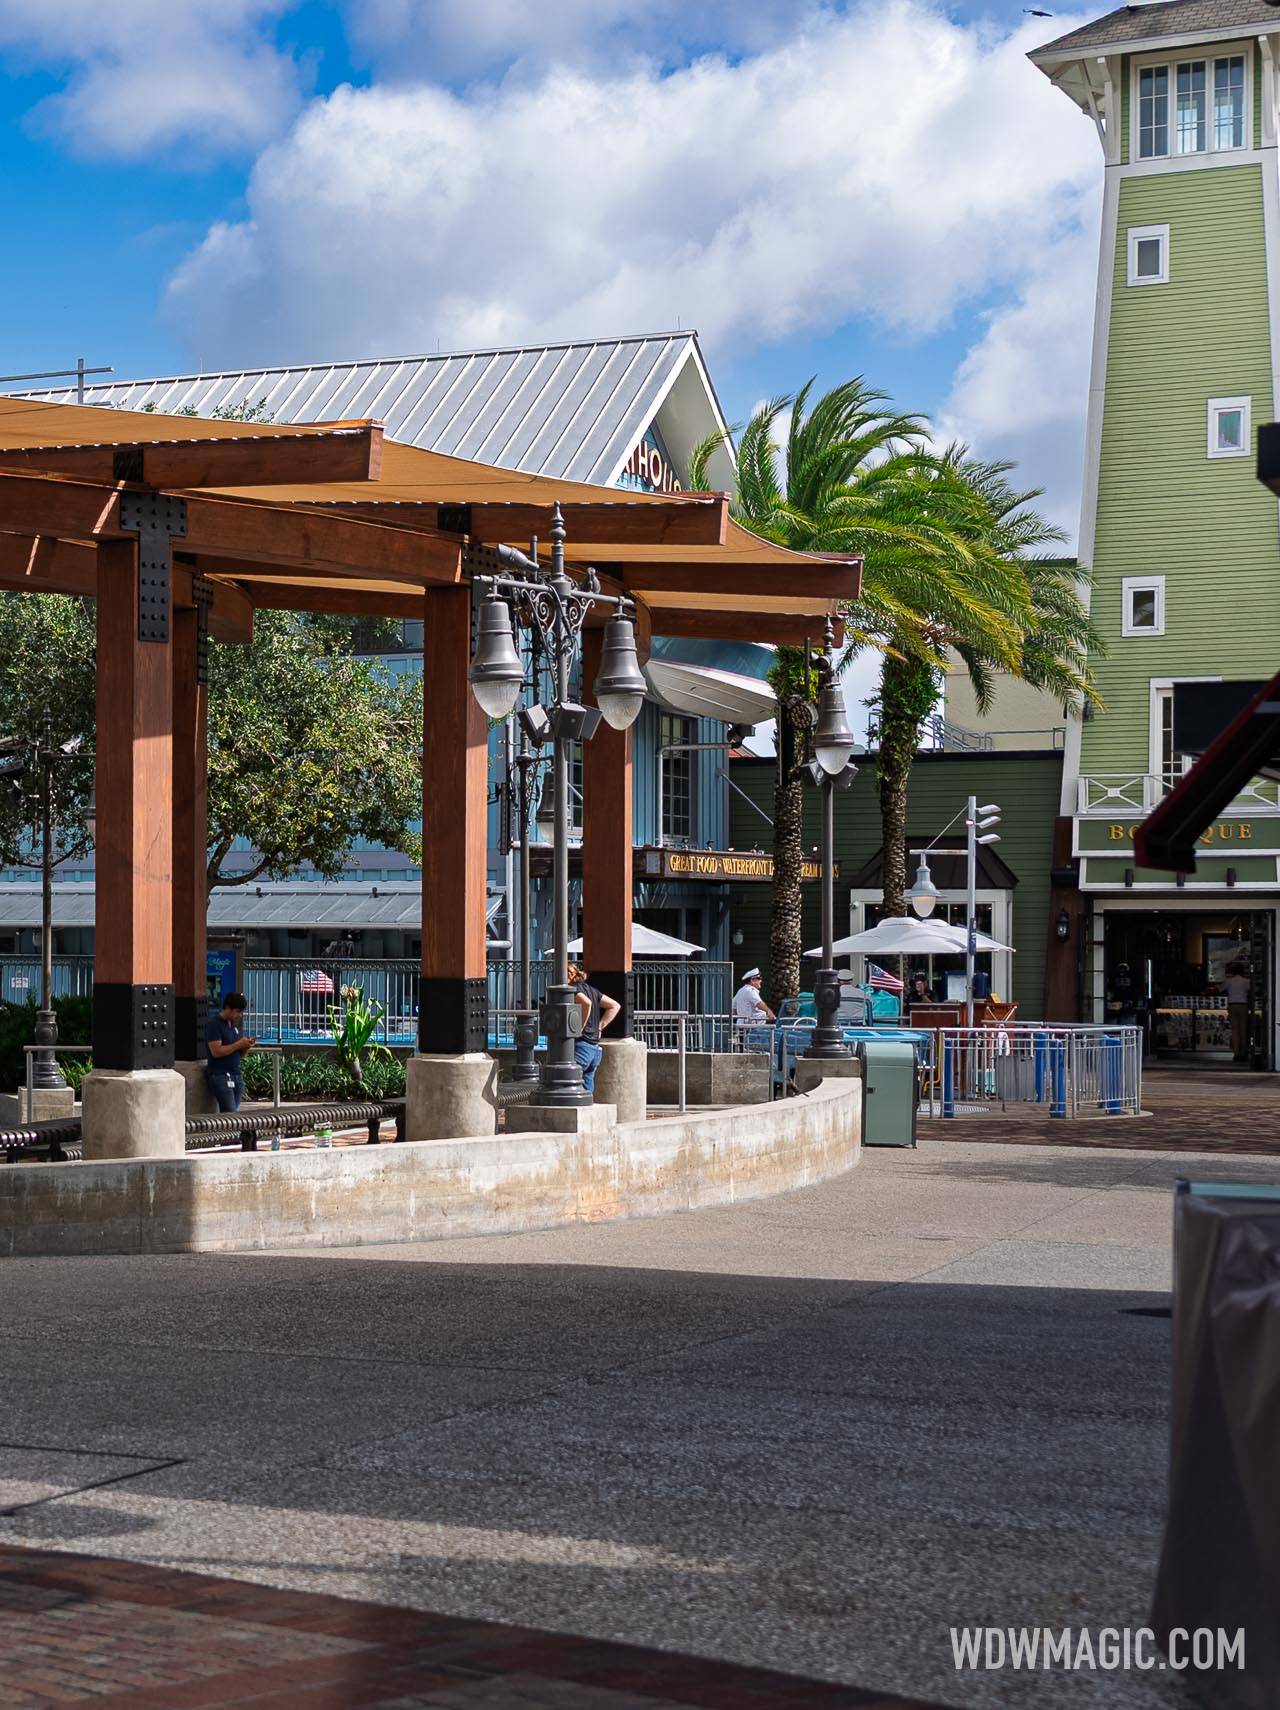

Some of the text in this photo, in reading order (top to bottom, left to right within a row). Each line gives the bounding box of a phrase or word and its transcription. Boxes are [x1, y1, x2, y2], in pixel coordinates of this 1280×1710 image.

[670, 855, 695, 872] GREAT
[696, 857, 718, 873] FOOD
[722, 858, 768, 875] WATERFRONT
